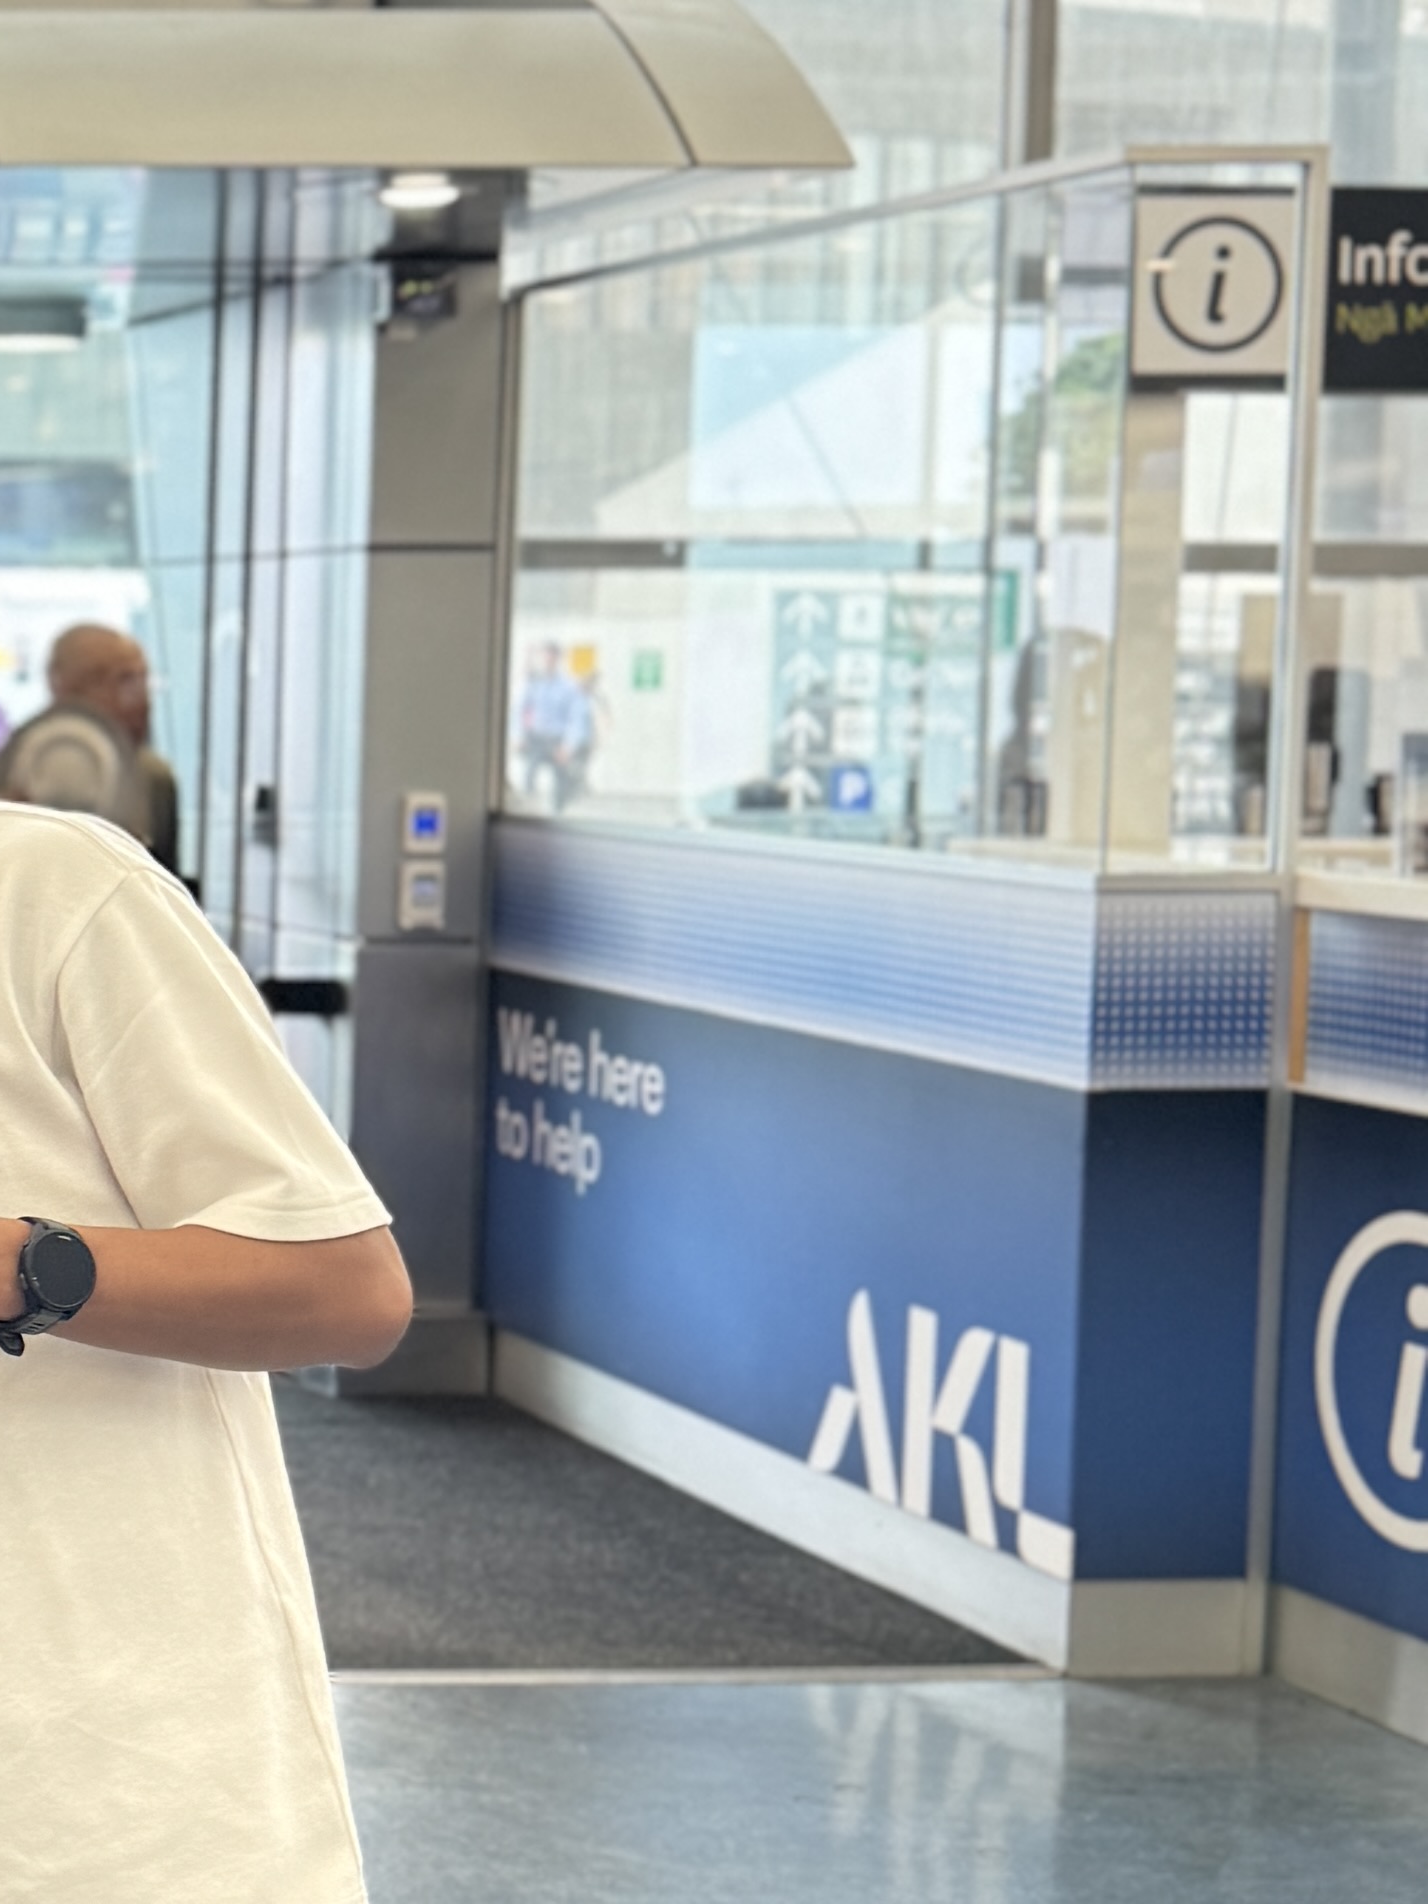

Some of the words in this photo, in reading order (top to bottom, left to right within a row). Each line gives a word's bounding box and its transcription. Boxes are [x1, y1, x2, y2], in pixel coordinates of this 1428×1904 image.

[498, 1007, 583, 1093] We're
[588, 1028, 665, 1116] here
[496, 1097, 529, 1161] to
[532, 1099, 602, 1196] help
[806, 1287, 1075, 1583] AKL
